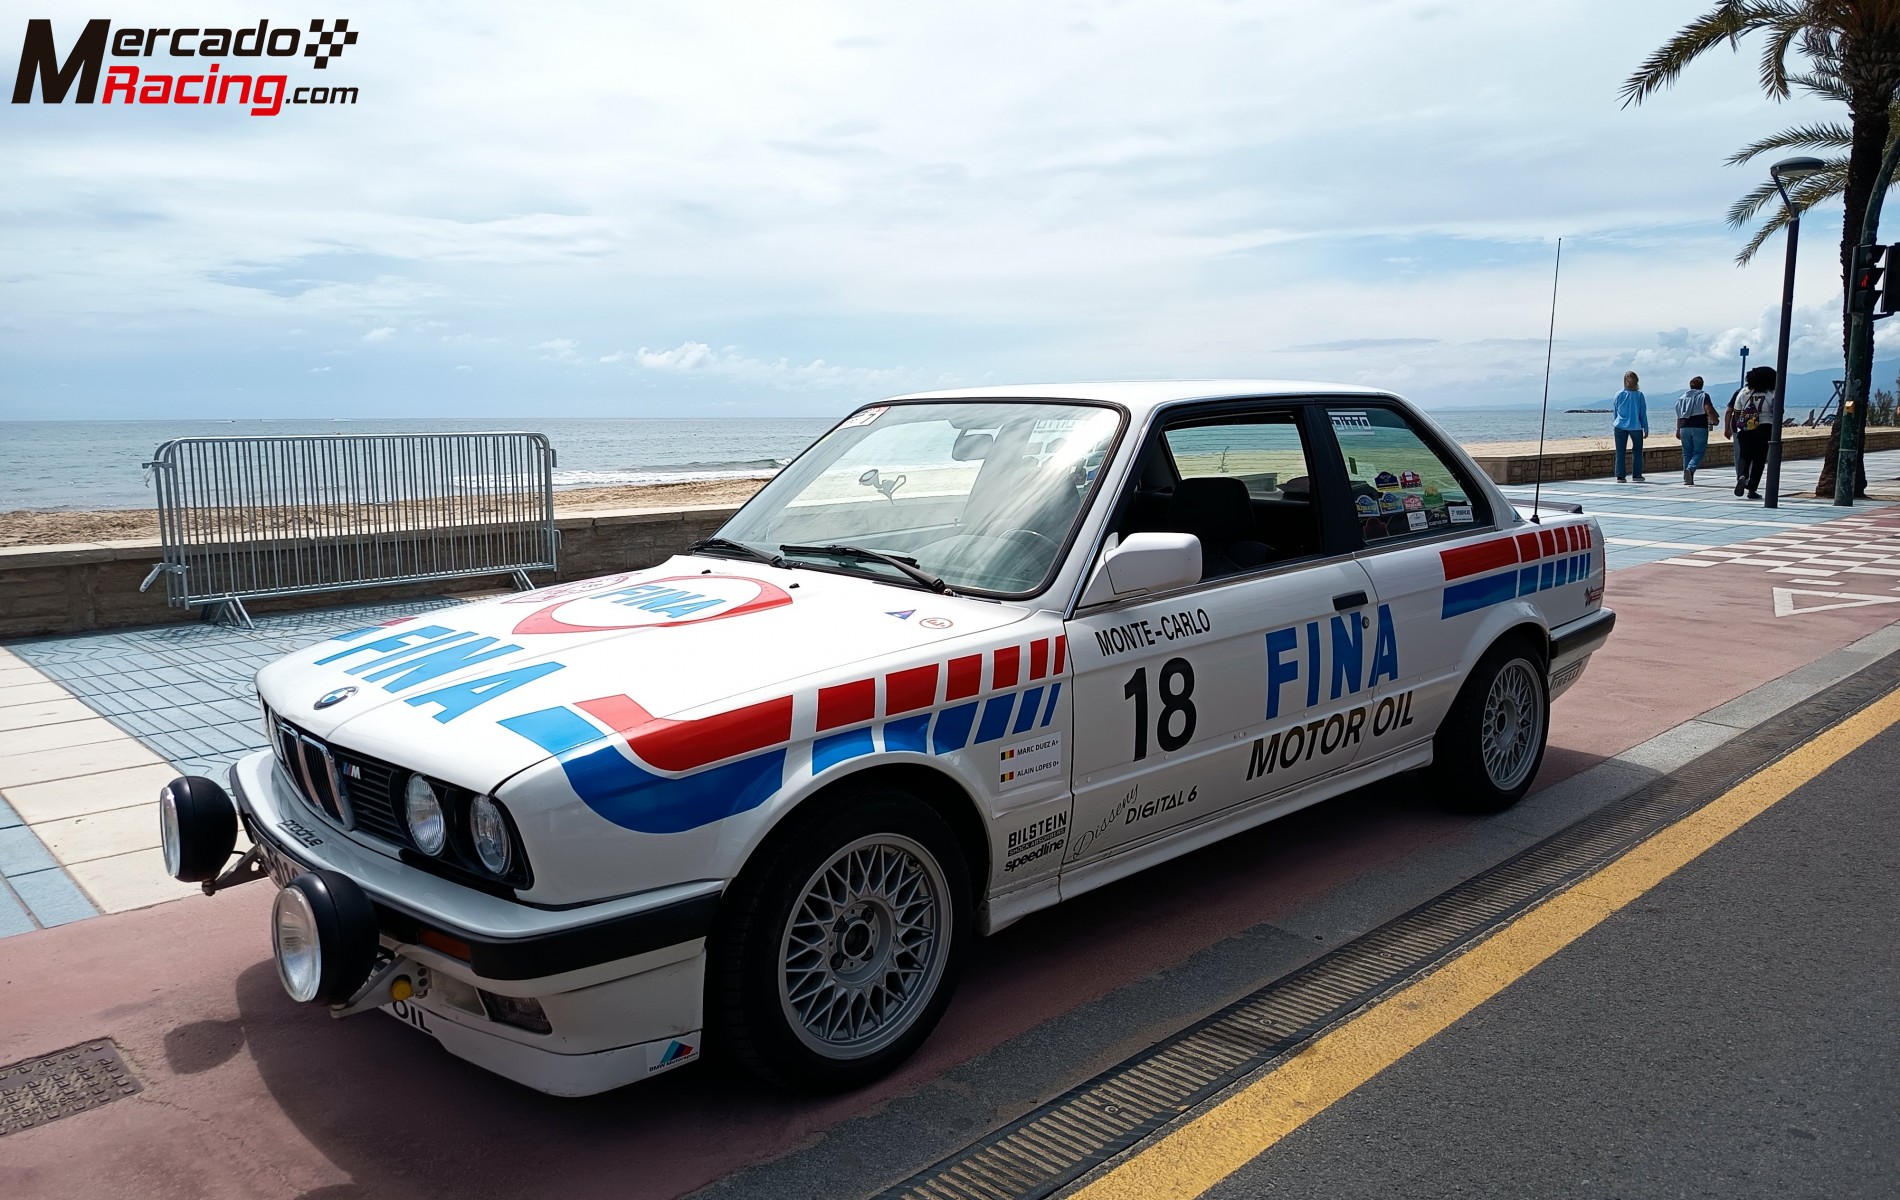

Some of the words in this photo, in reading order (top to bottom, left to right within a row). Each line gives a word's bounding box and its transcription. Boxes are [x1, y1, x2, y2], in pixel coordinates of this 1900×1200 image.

[589, 585, 727, 619] FINA
[1094, 608, 1211, 657] MONTE-CARLO
[313, 625, 567, 724] FINA
[1265, 603, 1399, 720] FINA
[1124, 656, 1197, 762] 18
[1017, 745, 1034, 756] MARC
[1036, 741, 1051, 751] DUEZ
[1246, 706, 1367, 781] MOTOR
[1373, 690, 1415, 738] OIL
[1017, 766, 1034, 777] ALAIN
[1035, 761, 1052, 772] LOPES
[1073, 783, 1139, 860] Disseny
[1125, 790, 1185, 825] DIGITAL
[1188, 784, 1198, 803] 6
[1008, 810, 1067, 849] BILSTEIN
[1004, 839, 1065, 872] speedline
[393, 999, 433, 1035] OIL
